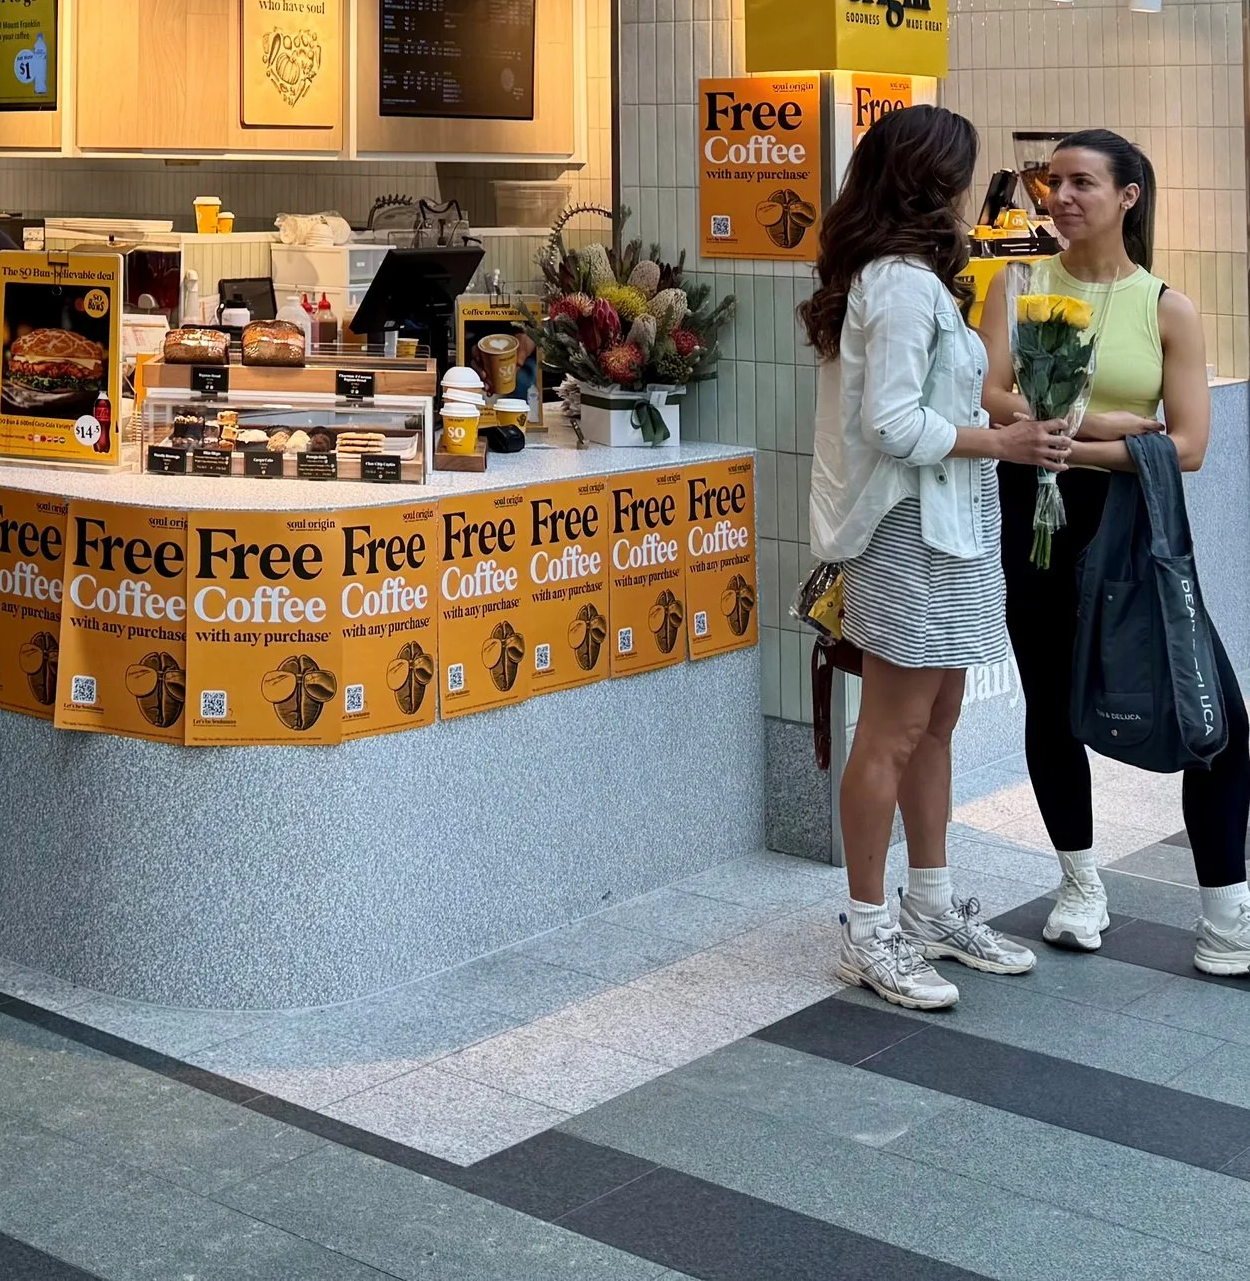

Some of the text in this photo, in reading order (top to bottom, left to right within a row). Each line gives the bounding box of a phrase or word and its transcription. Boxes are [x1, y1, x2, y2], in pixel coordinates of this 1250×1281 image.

[283, 0, 304, 12] have
[306, 2, 324, 14] soul
[846, 12, 942, 32] GOODNESS MADE GREAT
[20, 62, 31, 80] $1
[772, 82, 814, 93] soul origin
[704, 92, 802, 131] Free
[856, 87, 904, 126] Free
[704, 135, 806, 165] Coffee
[707, 169, 732, 180] with
[734, 171, 756, 182] any
[2, 267, 18, 276] The
[19, 267, 32, 276] SO
[97, 272, 114, 280] deal
[93, 294, 102, 302] SO
[448, 426, 466, 439] SO
[51, 503, 68, 516] origi
[494, 496, 524, 508] soul origin
[687, 478, 746, 522] Free
[402, 510, 434, 522] soul origin
[612, 488, 675, 534] Free
[149, 517, 188, 530] soul orig
[286, 518, 336, 532] soul origin
[530, 498, 598, 546] Free
[442, 512, 516, 562] Free
[688, 520, 748, 556] Coffee
[72, 517, 184, 578] Free
[196, 528, 323, 580] Free
[342, 526, 426, 577] Free
[612, 532, 678, 570] Coffee
[530, 544, 601, 584] Coffee
[689, 561, 706, 574] with
[707, 560, 720, 572] any
[441, 559, 518, 602] Coffee
[614, 574, 634, 588] with
[634, 572, 646, 586] any
[70, 574, 186, 622] Coffee
[194, 586, 326, 623] Coffee
[341, 576, 428, 619] Coffee
[532, 589, 550, 603] with
[551, 588, 566, 602] any
[1, 602, 20, 615] any
[21, 606, 60, 623] purchas
[443, 606, 464, 620] with
[464, 604, 481, 618] any
[70, 616, 100, 632] with
[102, 620, 127, 638] any
[342, 624, 366, 639] with
[368, 624, 386, 638] any
[196, 629, 230, 643] with
[234, 633, 260, 646] any
